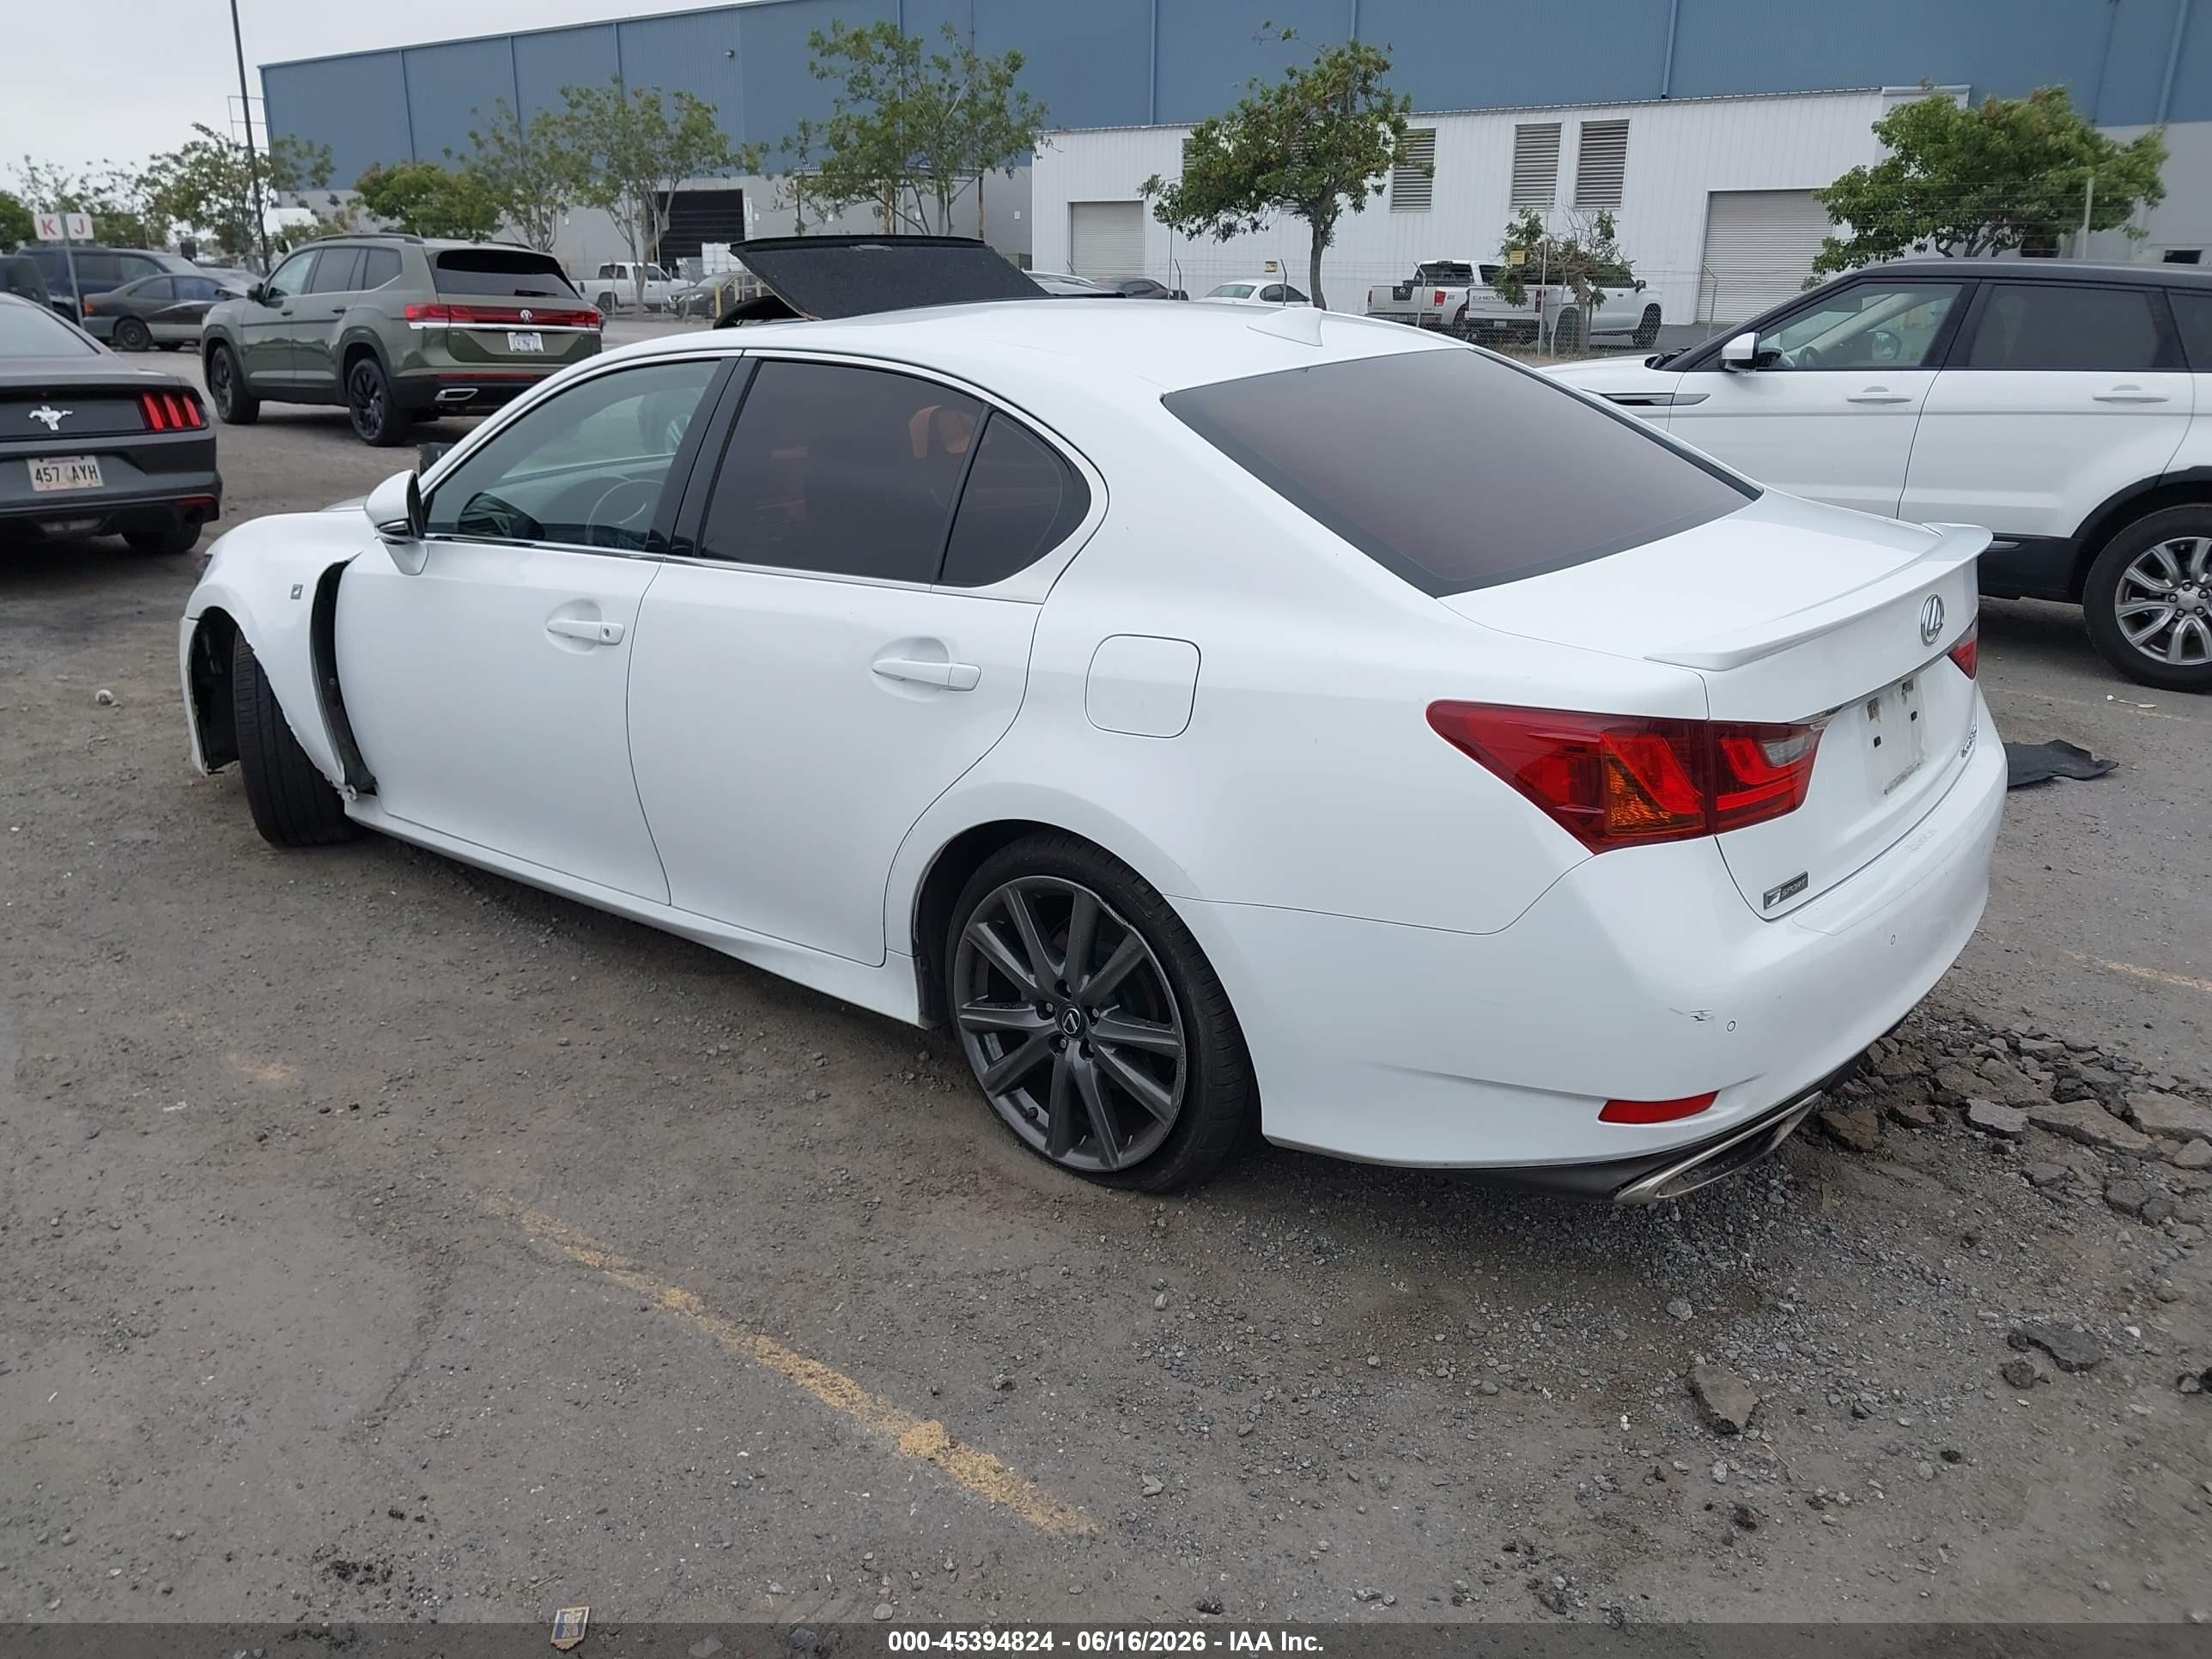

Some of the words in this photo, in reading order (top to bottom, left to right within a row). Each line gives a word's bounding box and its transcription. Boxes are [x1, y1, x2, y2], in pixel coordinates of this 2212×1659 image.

[41, 219, 57, 235] K
[75, 218, 85, 234] J
[35, 466, 60, 483] 457
[71, 464, 99, 481] AYH
[1781, 878, 1807, 897] SPORT
